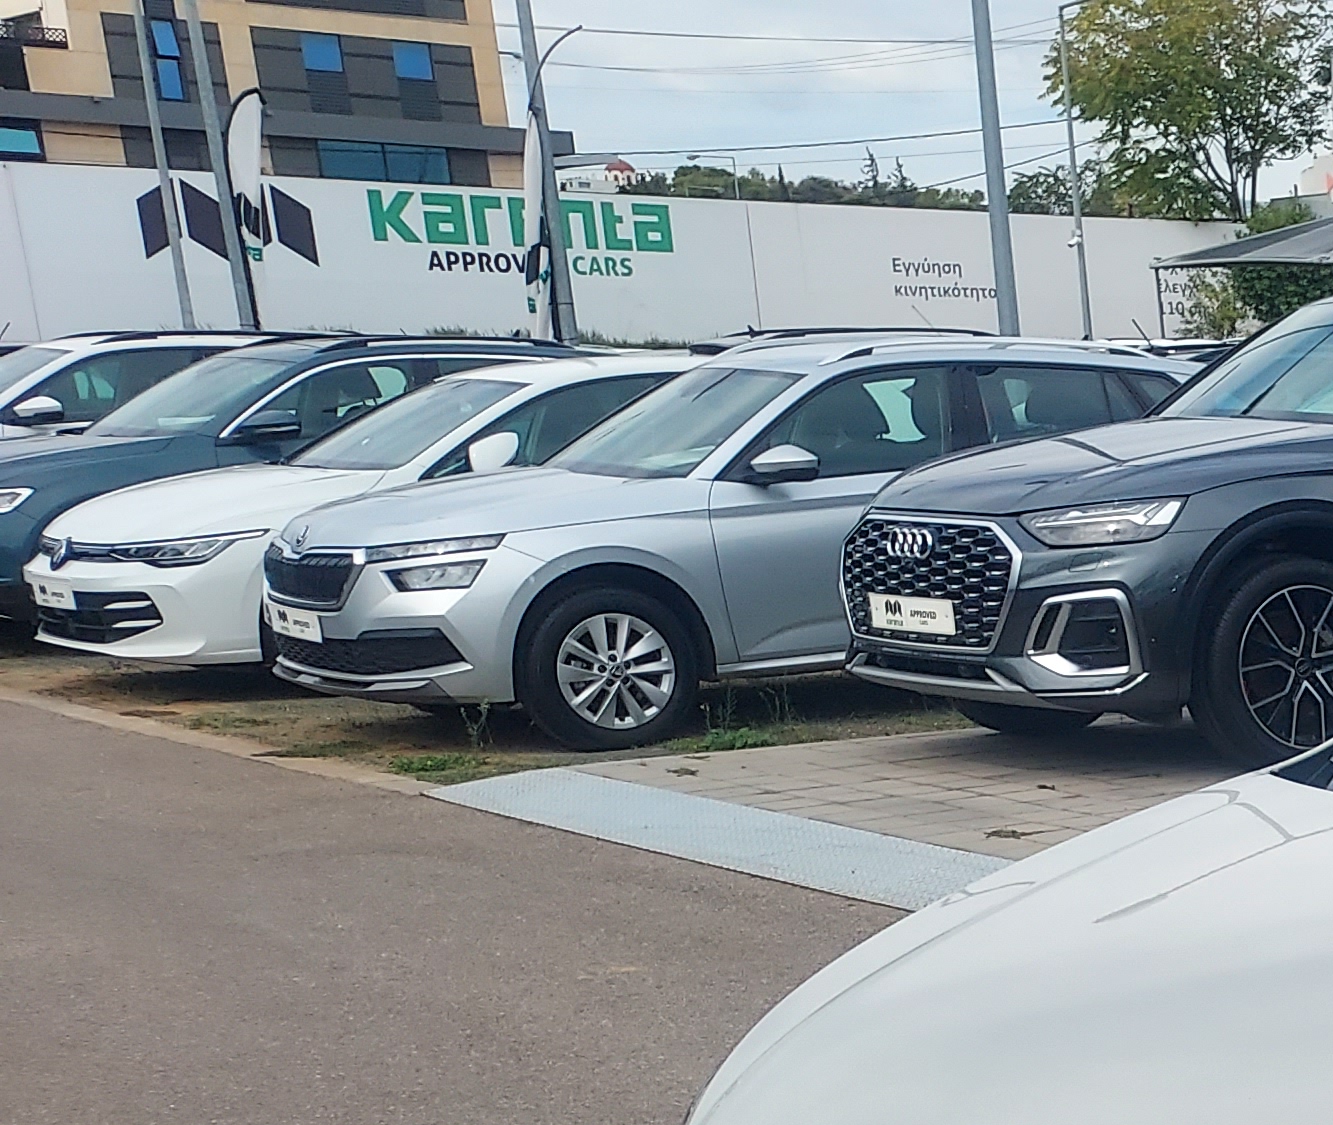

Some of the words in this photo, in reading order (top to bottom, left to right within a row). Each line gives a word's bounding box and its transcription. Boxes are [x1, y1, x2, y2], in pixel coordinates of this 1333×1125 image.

[428, 250, 526, 274] APPROV
[572, 255, 634, 277] CARS
[891, 257, 963, 279] Εγγύηση
